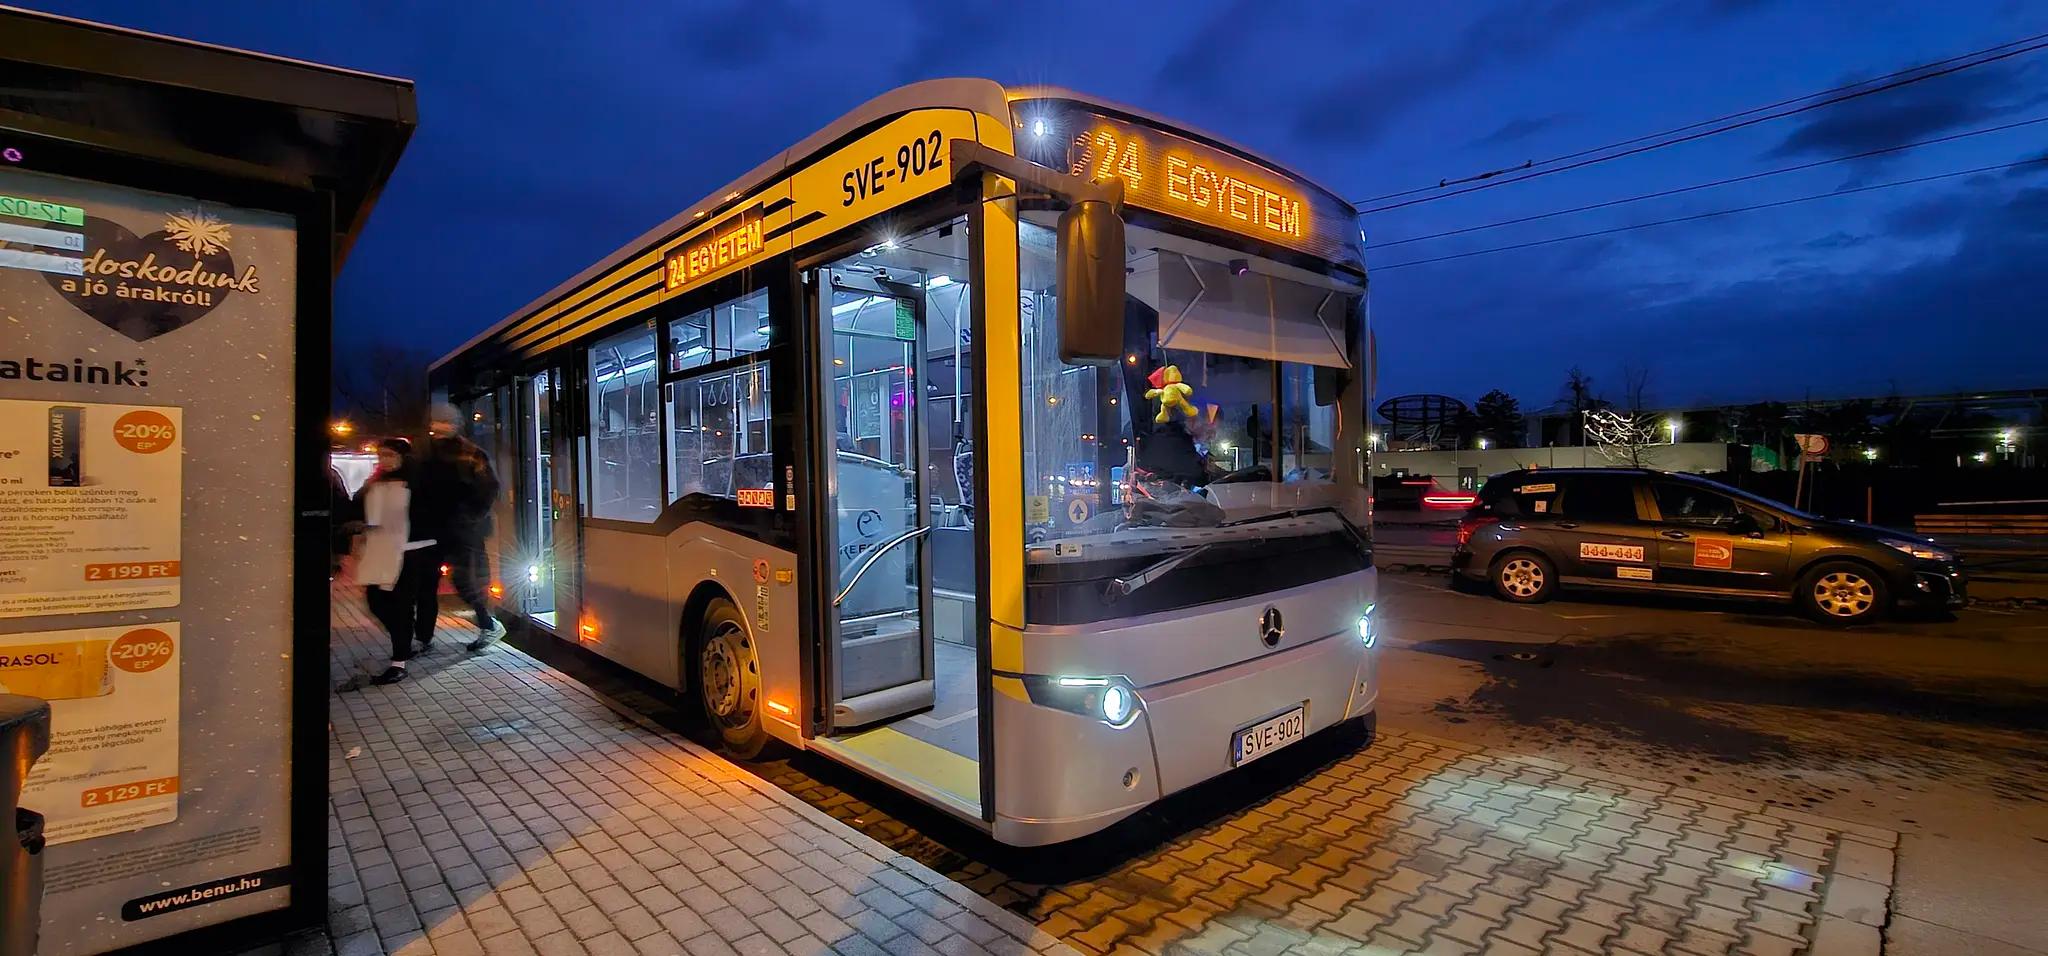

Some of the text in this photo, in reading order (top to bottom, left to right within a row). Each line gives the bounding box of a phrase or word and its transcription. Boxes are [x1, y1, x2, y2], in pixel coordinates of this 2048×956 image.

[842, 129, 943, 207] SVE-902
[1167, 155, 1300, 237] EGYETEM
[667, 219, 761, 288] 24 EGYETEM
[61, 279, 211, 307] a jó árakról!
[1581, 544, 1642, 560] 444-444
[90, 568, 102, 579] 2
[109, 566, 143, 578] 199
[111, 642, 170, 659] -20%
[1245, 715, 1300, 755] SVE-902
[86, 793, 98, 805] 2
[105, 786, 140, 802] 129
[140, 878, 261, 914] www.benu.hu
